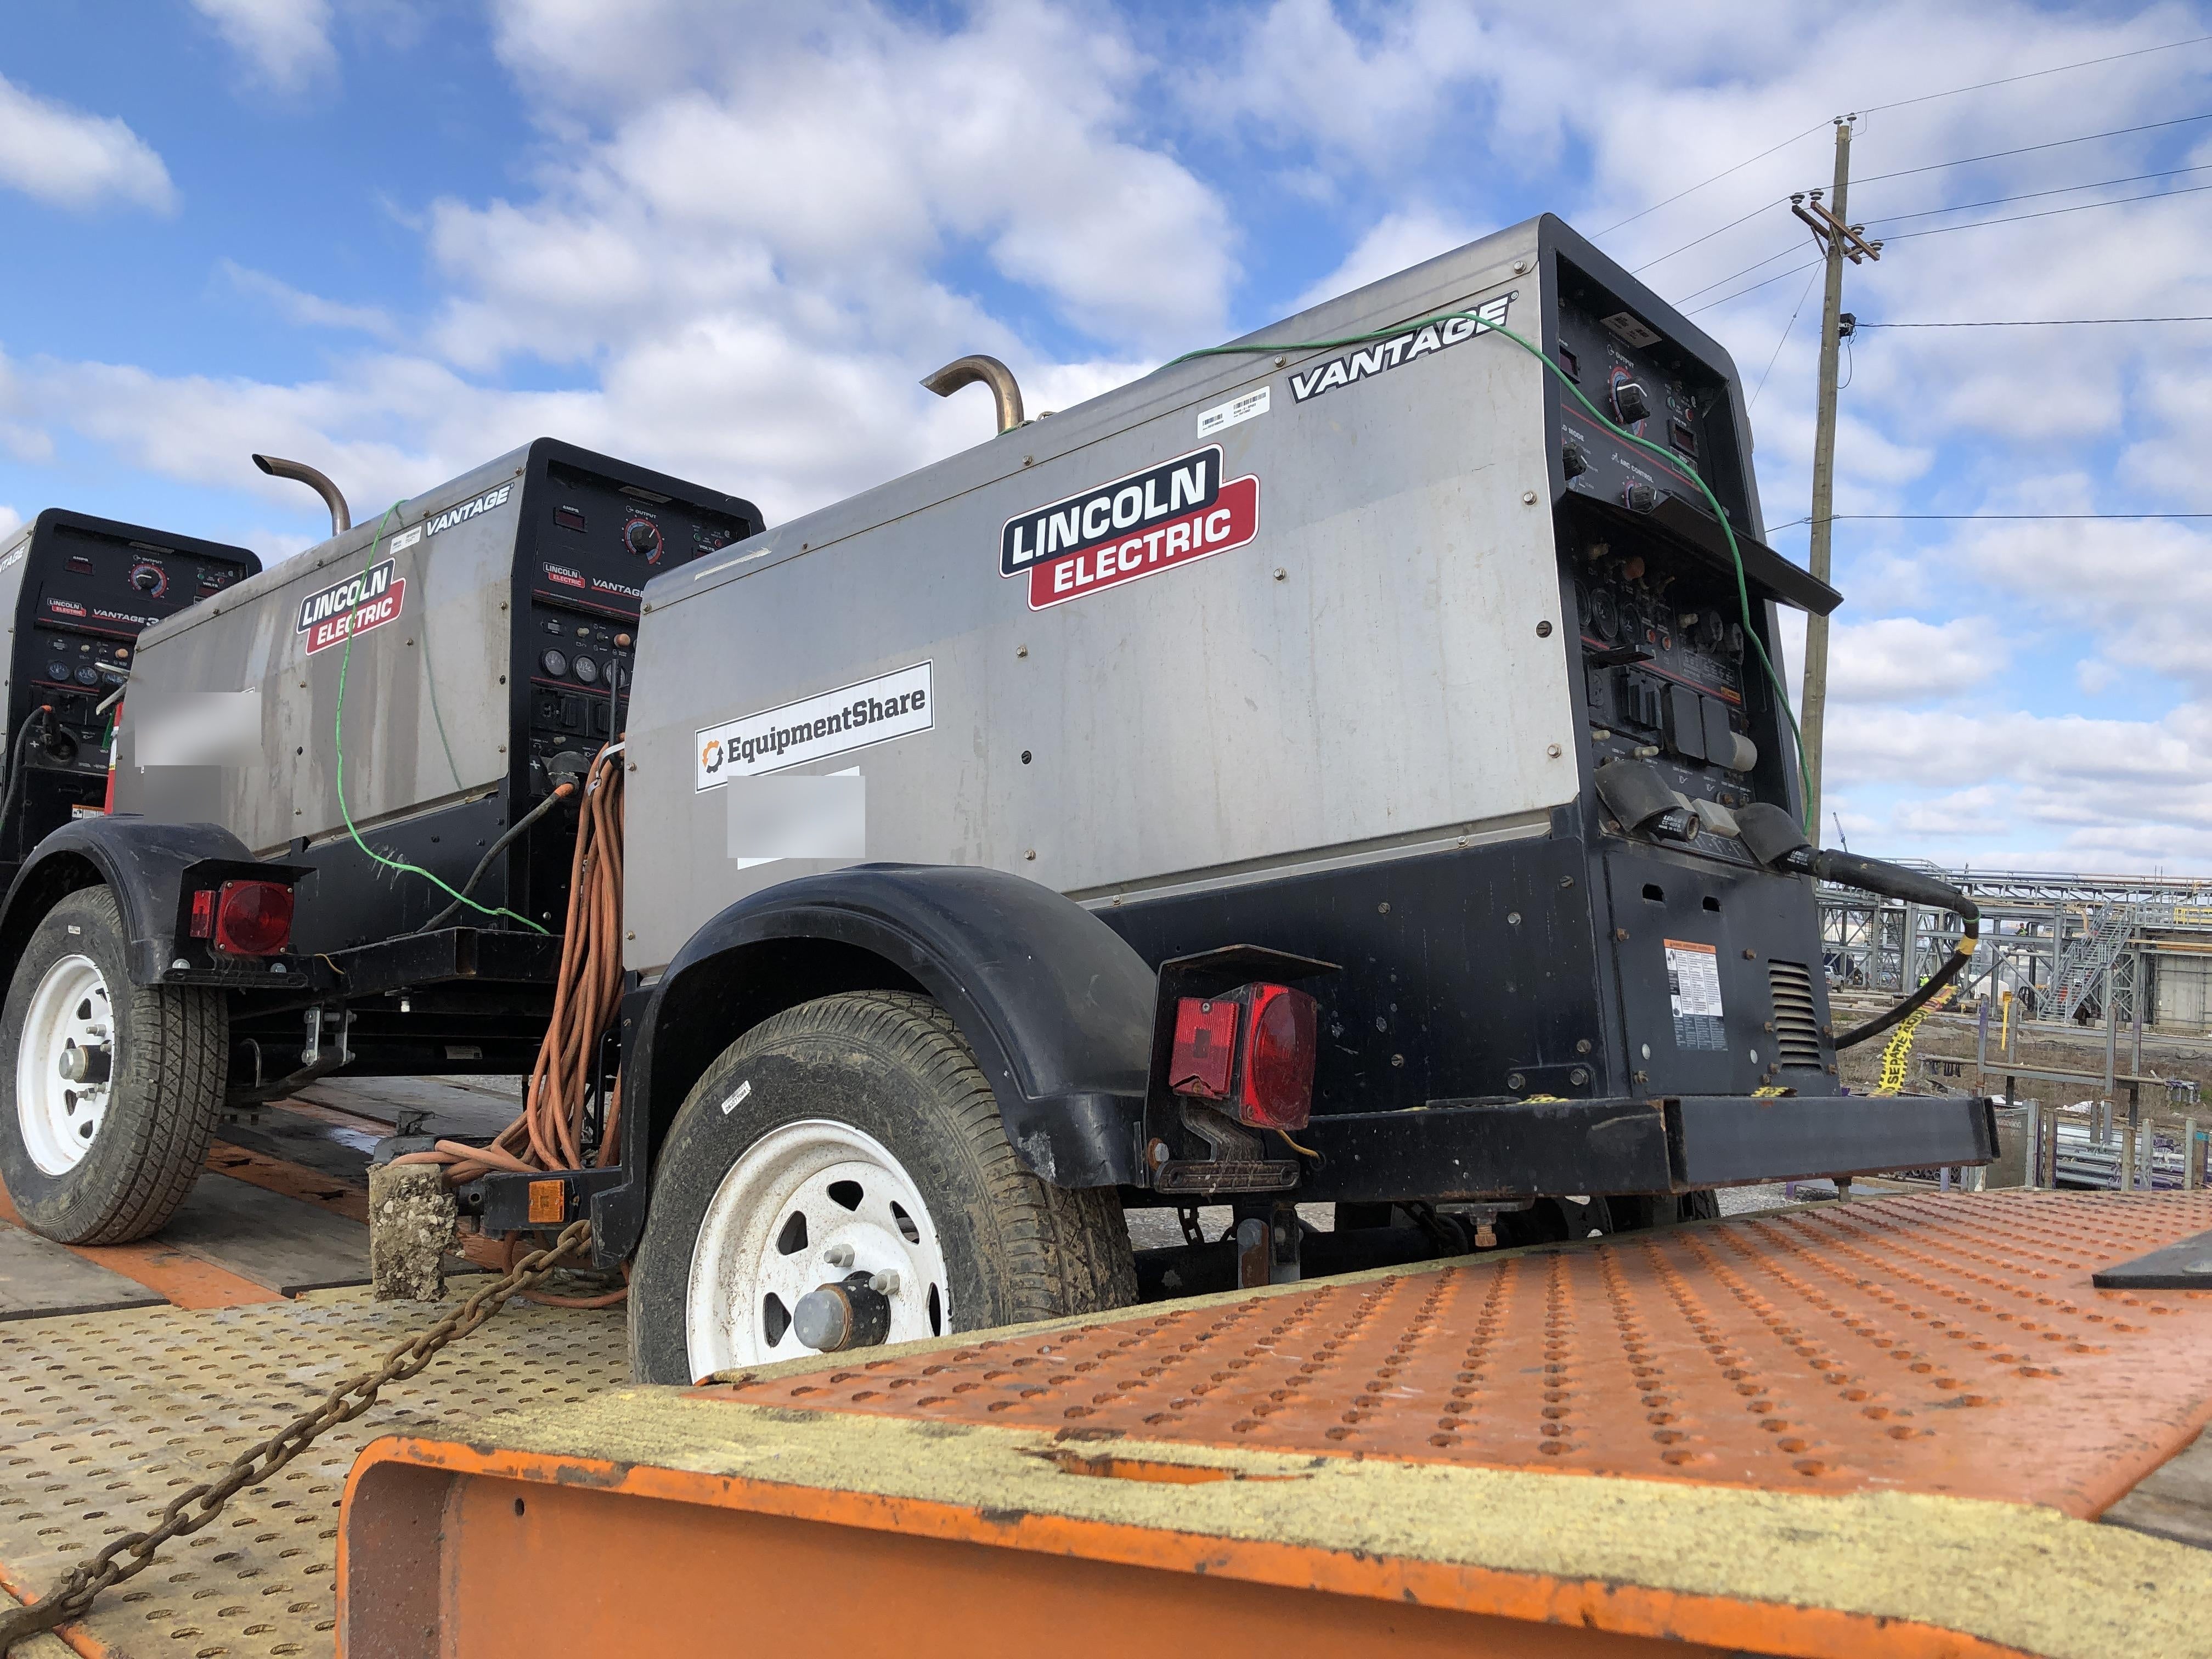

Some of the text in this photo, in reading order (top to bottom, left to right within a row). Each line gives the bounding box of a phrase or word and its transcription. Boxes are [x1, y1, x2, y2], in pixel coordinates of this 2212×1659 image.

[1291, 296, 1509, 400] VANTAGE
[1615, 351, 1634, 369] OUTPUT
[1568, 427, 1585, 442] MODE
[1620, 459, 1654, 483] ARC CONTROL
[426, 485, 510, 537] VANTAGE
[562, 505, 579, 513] AMPS
[635, 509, 657, 519] OUTPUT
[1012, 460, 1206, 565] LINCOLN
[1053, 507, 1232, 594] ELECTRIC
[545, 564, 578, 578] LINCOLN
[552, 574, 582, 586] ELECTRIC
[49, 599, 80, 610] LINCOLN
[303, 566, 388, 627] LINCOLN
[56, 606, 82, 615] ELECTRIC
[93, 608, 145, 624] VANTAGE
[317, 597, 393, 646] ELECTRIC
[727, 689, 926, 764] EquipmentShare
[1887, 1034, 1908, 1085] SEPARE
